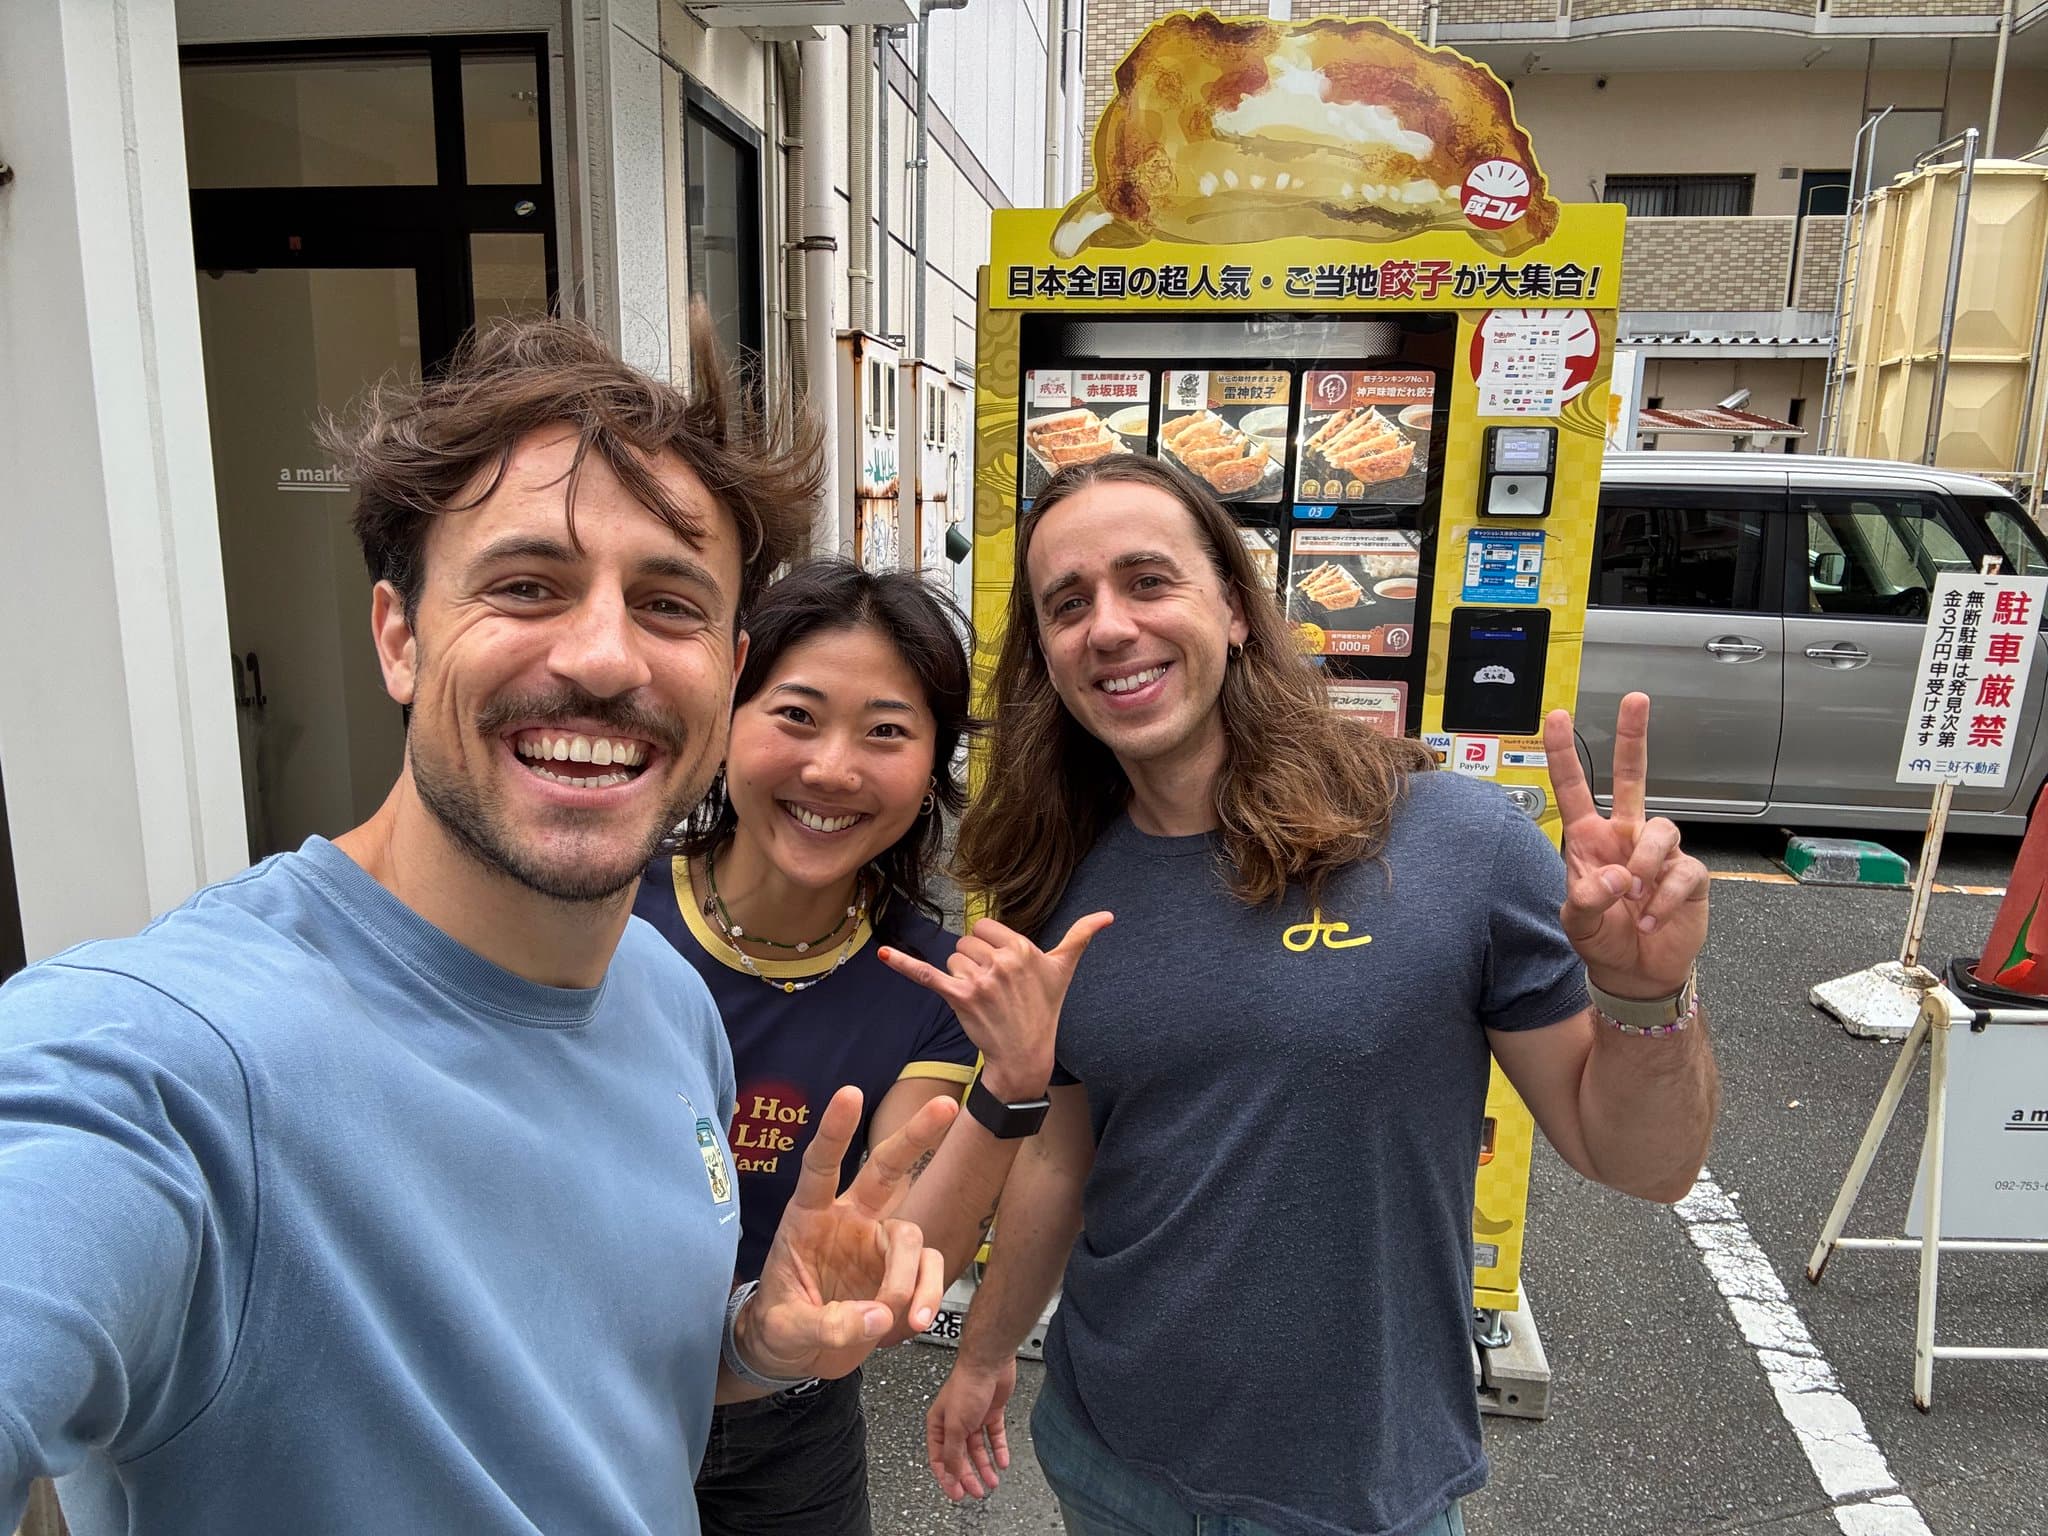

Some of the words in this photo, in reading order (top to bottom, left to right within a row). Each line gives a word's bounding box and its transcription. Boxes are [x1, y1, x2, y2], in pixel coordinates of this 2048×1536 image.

[1224, 386, 1277, 400] 雷神餃子
[280, 468, 291, 481] a
[1308, 507, 1322, 518] 03
[1936, 590, 1986, 749] 無断駐車は発見次第
[1967, 590, 2033, 747] 駐車厳禁
[1426, 737, 1450, 747] VISA
[1459, 762, 1490, 772] PayPay
[1933, 760, 2001, 775] 三好不動産
[750, 1096, 810, 1125] Hot
[2011, 1109, 2025, 1122] a
[735, 1124, 795, 1152] Life
